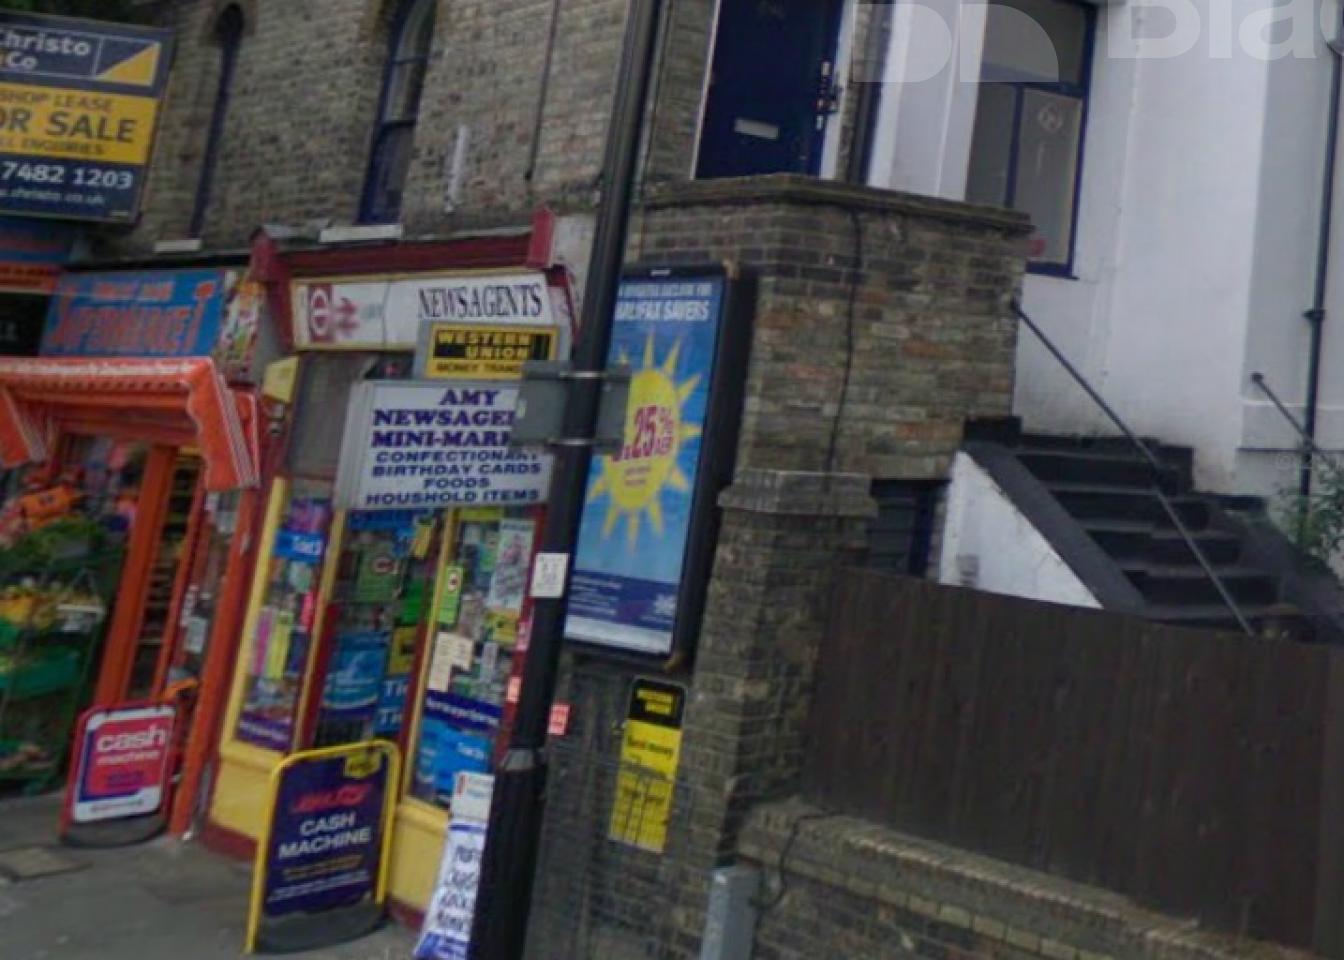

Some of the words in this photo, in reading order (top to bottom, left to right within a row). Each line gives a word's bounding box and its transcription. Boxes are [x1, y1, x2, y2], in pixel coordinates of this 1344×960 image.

[2, 29, 92, 57] hristo
[46, 110, 137, 144] SALE
[0, 160, 65, 185] 7482
[72, 167, 134, 190] 1203
[418, 284, 543, 319] NEWSAGENTS
[437, 330, 531, 346] WESTERN
[464, 344, 530, 361] UNION
[439, 389, 499, 407] AMY
[372, 463, 473, 478] BIRTHDAY
[479, 461, 542, 475] CARDS
[423, 477, 491, 490] FOODS
[365, 492, 478, 505] HOUSHOLD
[483, 489, 540, 502] ITEMS
[95, 723, 166, 753] cash
[300, 810, 357, 836] CASH
[277, 825, 373, 860] MACHINE
